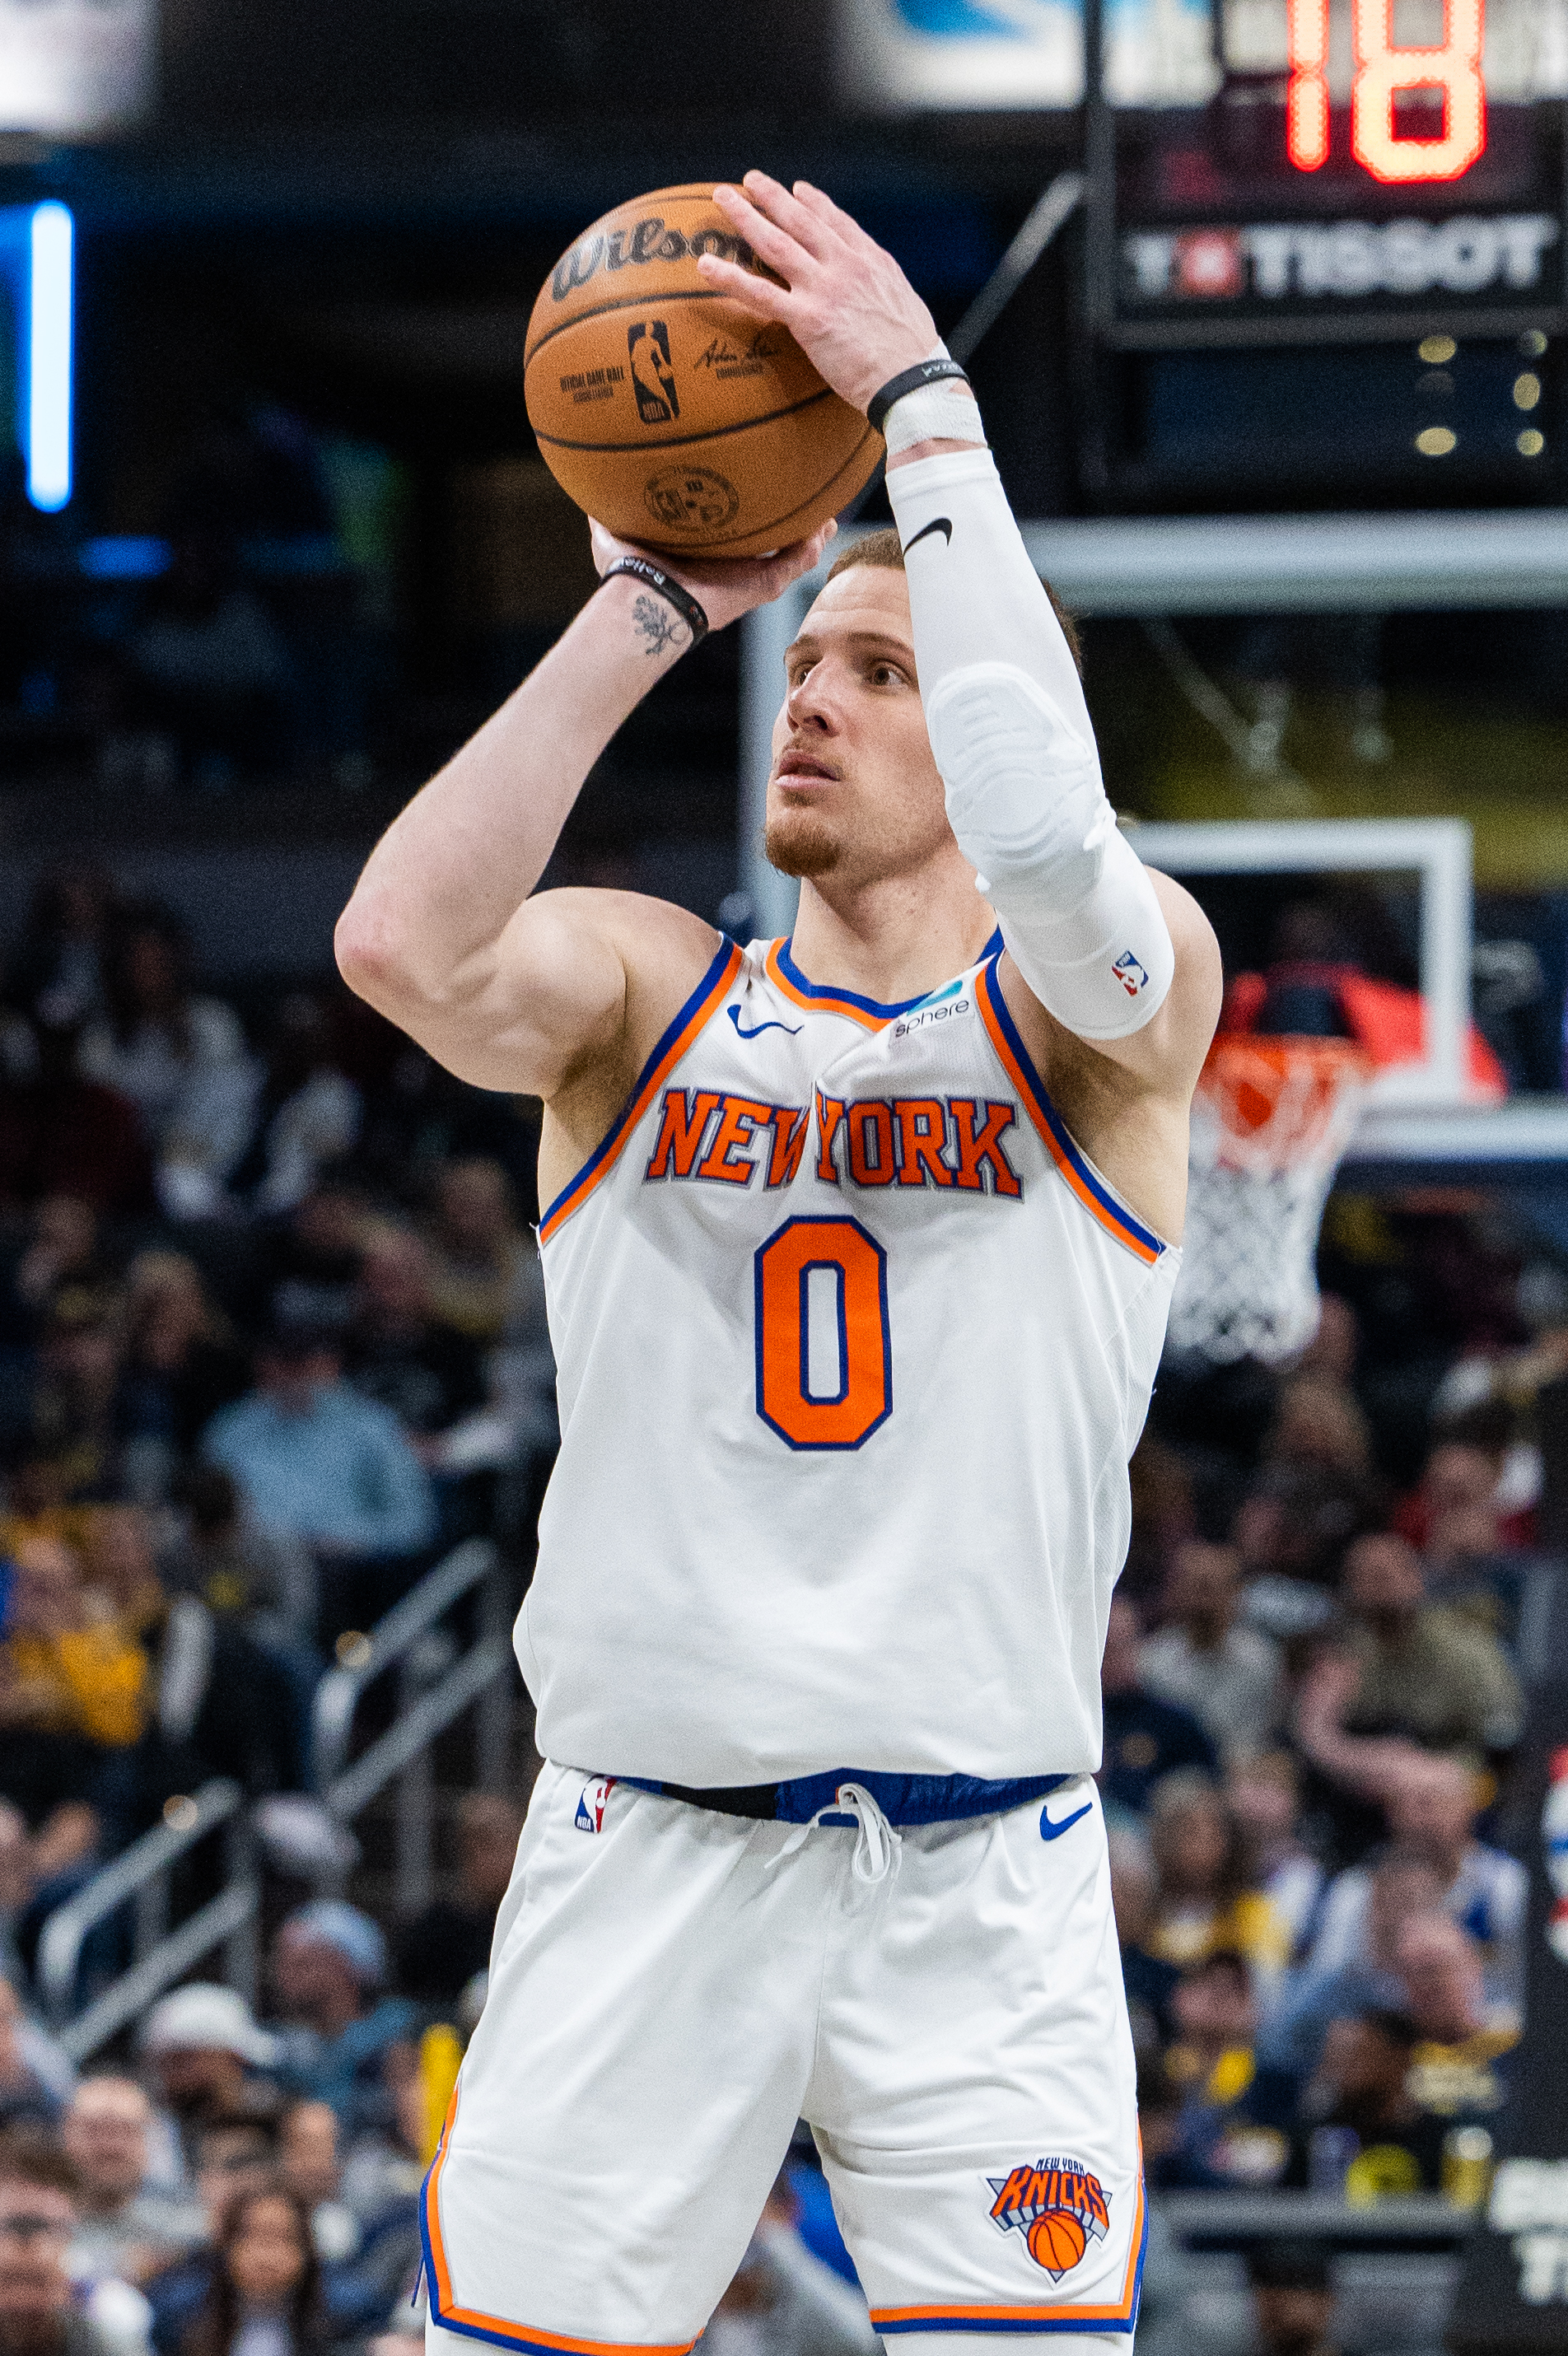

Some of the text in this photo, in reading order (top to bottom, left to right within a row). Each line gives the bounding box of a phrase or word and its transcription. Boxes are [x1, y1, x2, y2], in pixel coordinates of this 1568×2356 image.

[1287, 0, 1486, 184] 18
[895, 1000, 969, 1038] sphere
[642, 1084, 1024, 1203] NEW YORK
[754, 1215, 893, 1451] 0
[577, 1815, 591, 1831] NBA
[990, 2164, 1109, 2231] KNICKS
[1035, 2157, 1085, 2175] NEW YORK
